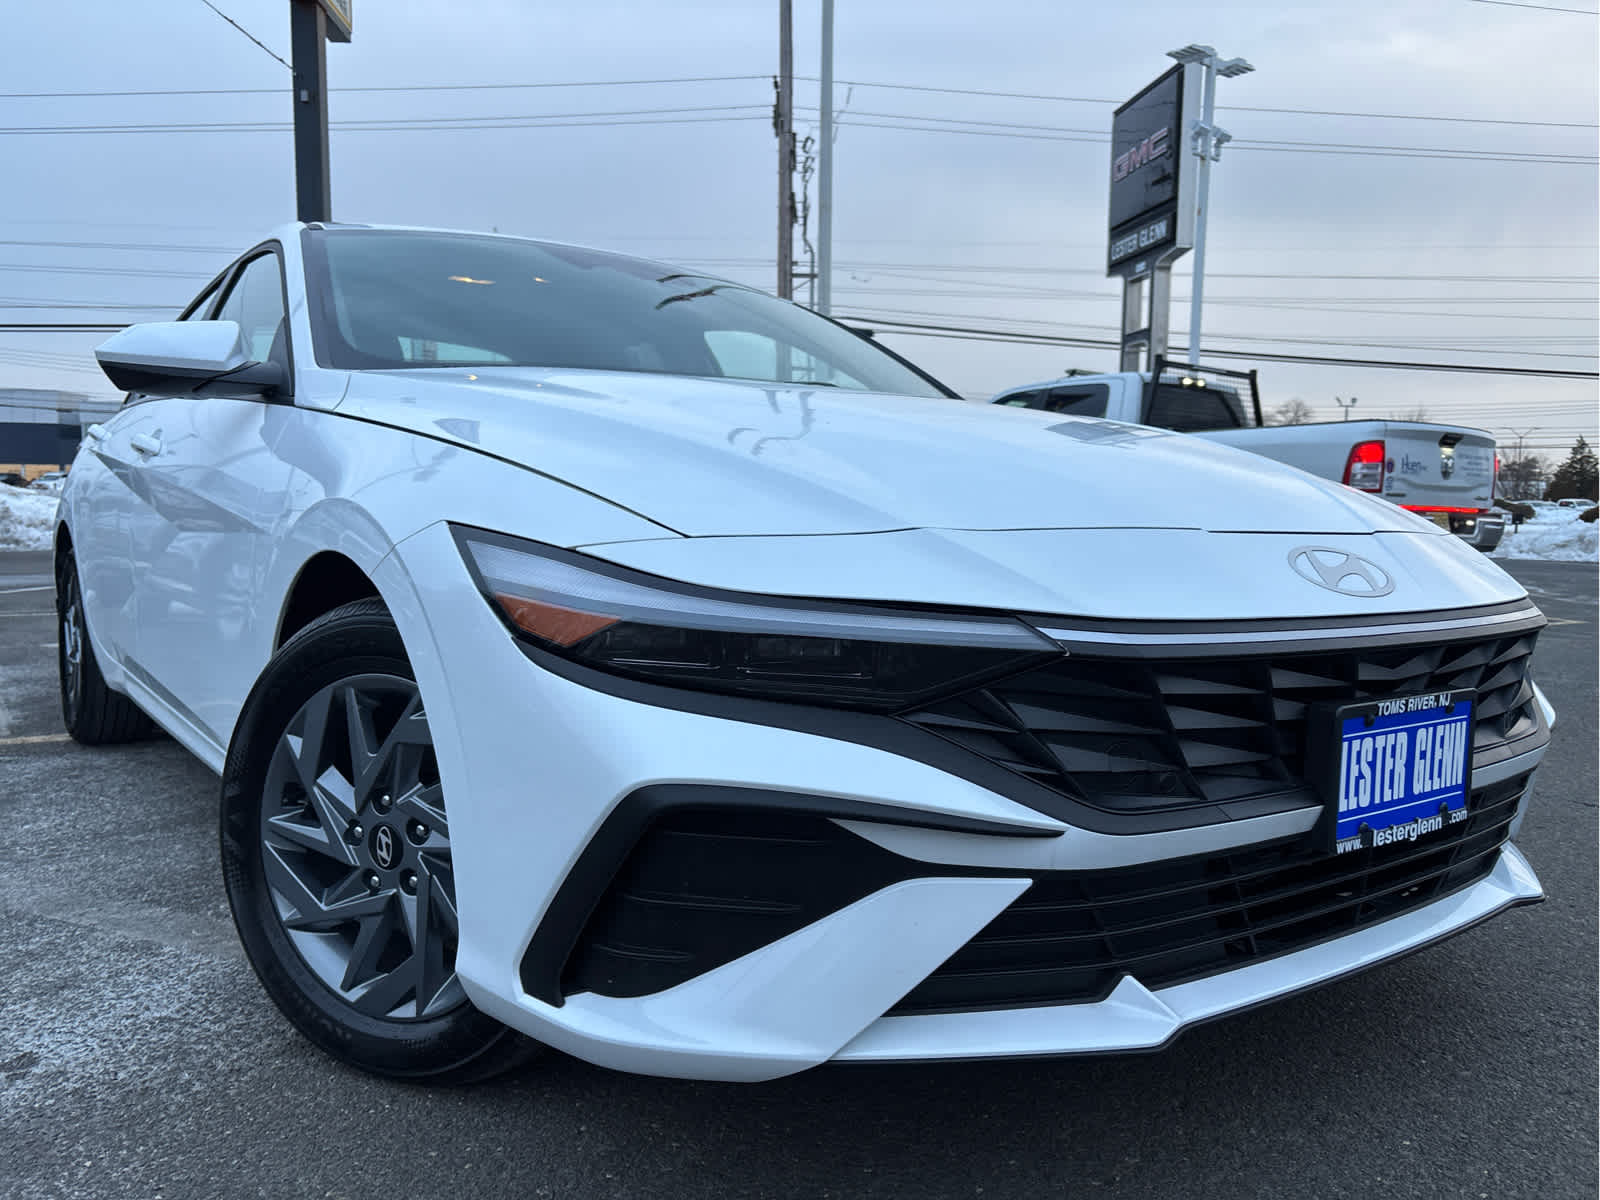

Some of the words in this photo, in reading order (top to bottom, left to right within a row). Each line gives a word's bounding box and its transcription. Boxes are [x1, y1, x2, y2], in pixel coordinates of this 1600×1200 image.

[1113, 127, 1168, 182] GMC
[1139, 220, 1167, 247] GLENN
[1378, 701, 1406, 716] TOMS
[1438, 693, 1451, 708] NJ
[1338, 731, 1408, 812] LESTER
[1413, 720, 1467, 796] GLENN
